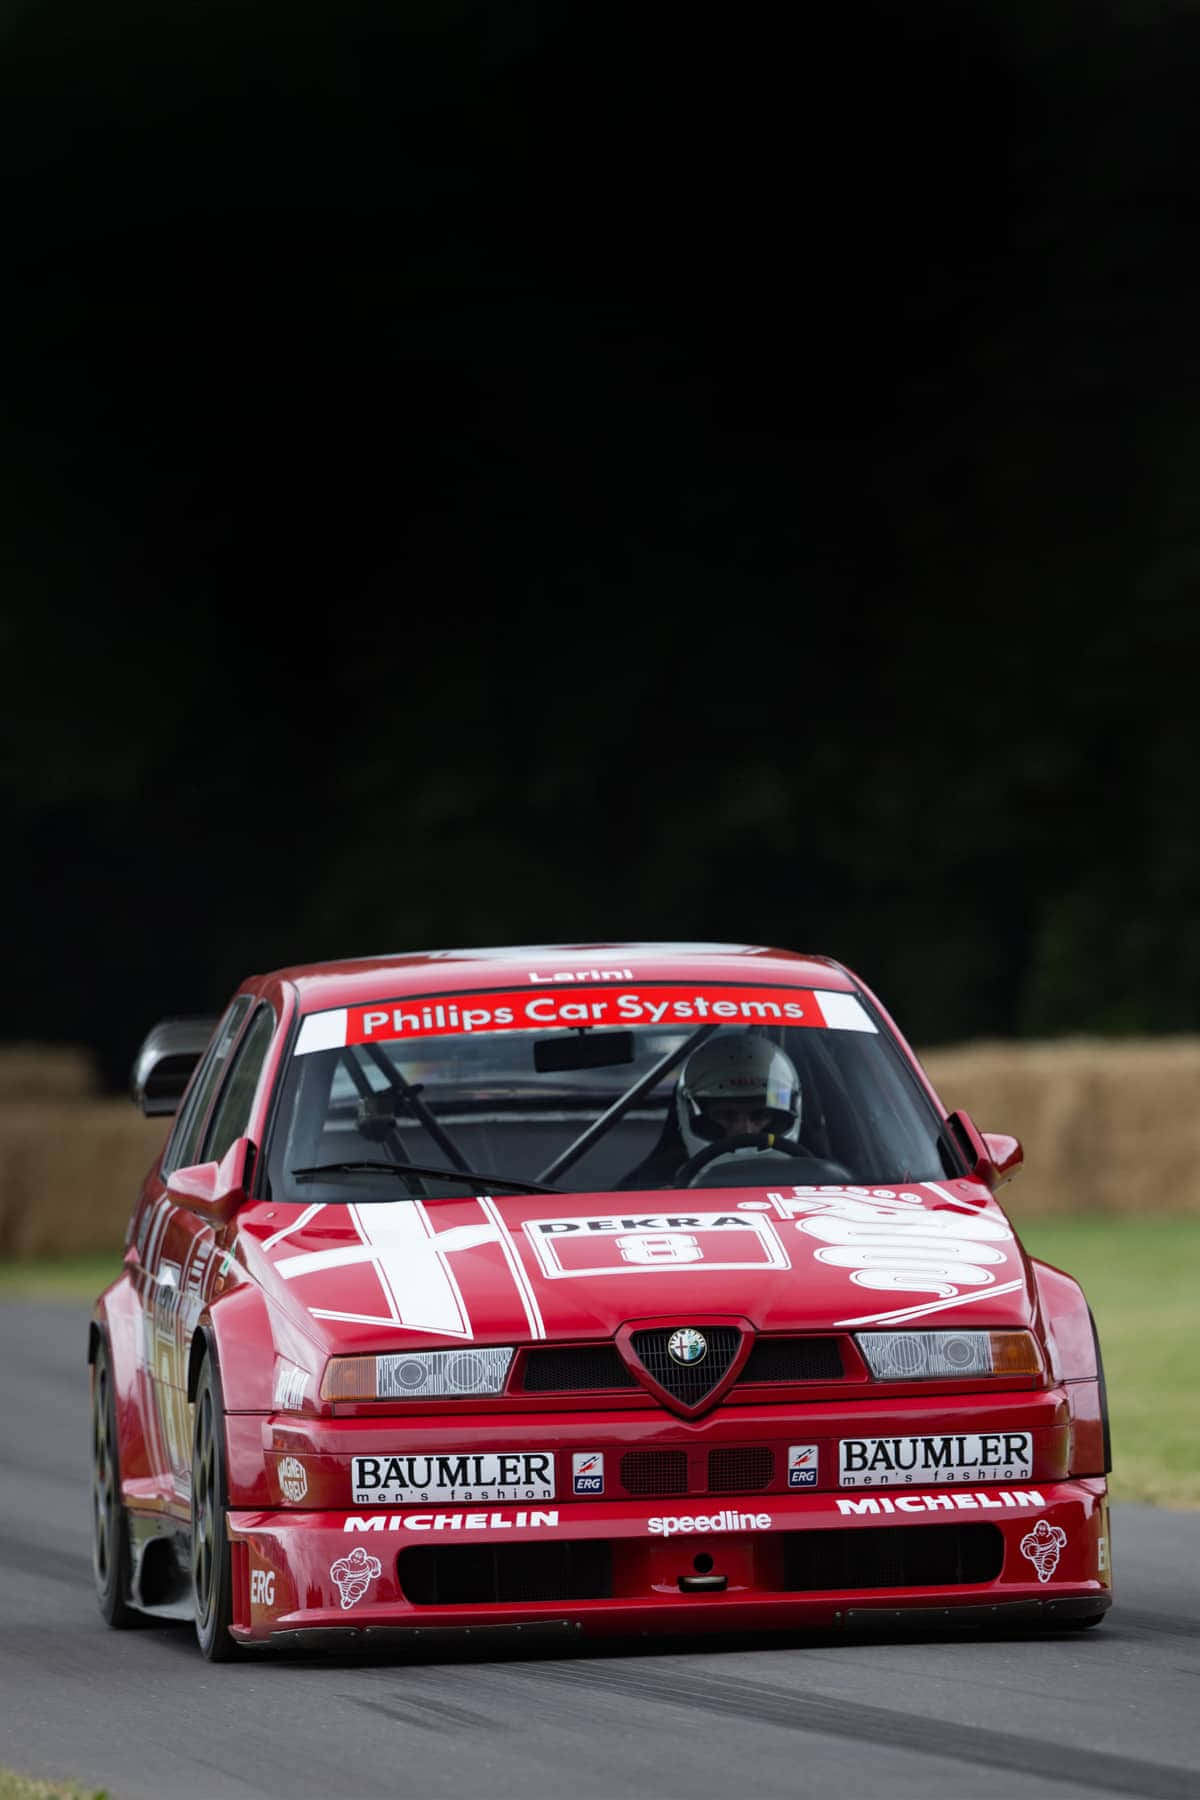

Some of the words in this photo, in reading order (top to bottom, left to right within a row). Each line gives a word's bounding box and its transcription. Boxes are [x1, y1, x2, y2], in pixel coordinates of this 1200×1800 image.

[528, 969, 633, 983] Larini
[362, 1004, 514, 1036] Philips
[525, 998, 608, 1022] Car
[616, 994, 804, 1023] Systems
[538, 1216, 753, 1234] DEKRA
[615, 1233, 705, 1265] 8
[842, 1434, 1029, 1472] BÄUMLER
[355, 1454, 552, 1490] BÄUMLER
[576, 1478, 602, 1490] ERG
[790, 1471, 816, 1483] ERG
[842, 1471, 914, 1486] men's
[934, 1467, 1029, 1481] fashion
[356, 1489, 430, 1503] men's
[450, 1487, 552, 1501] fashion
[835, 1490, 1047, 1516] MICHELIN
[343, 1510, 560, 1532] MICHELIN
[647, 1510, 772, 1537] speedline
[250, 1569, 276, 1606] ERG
